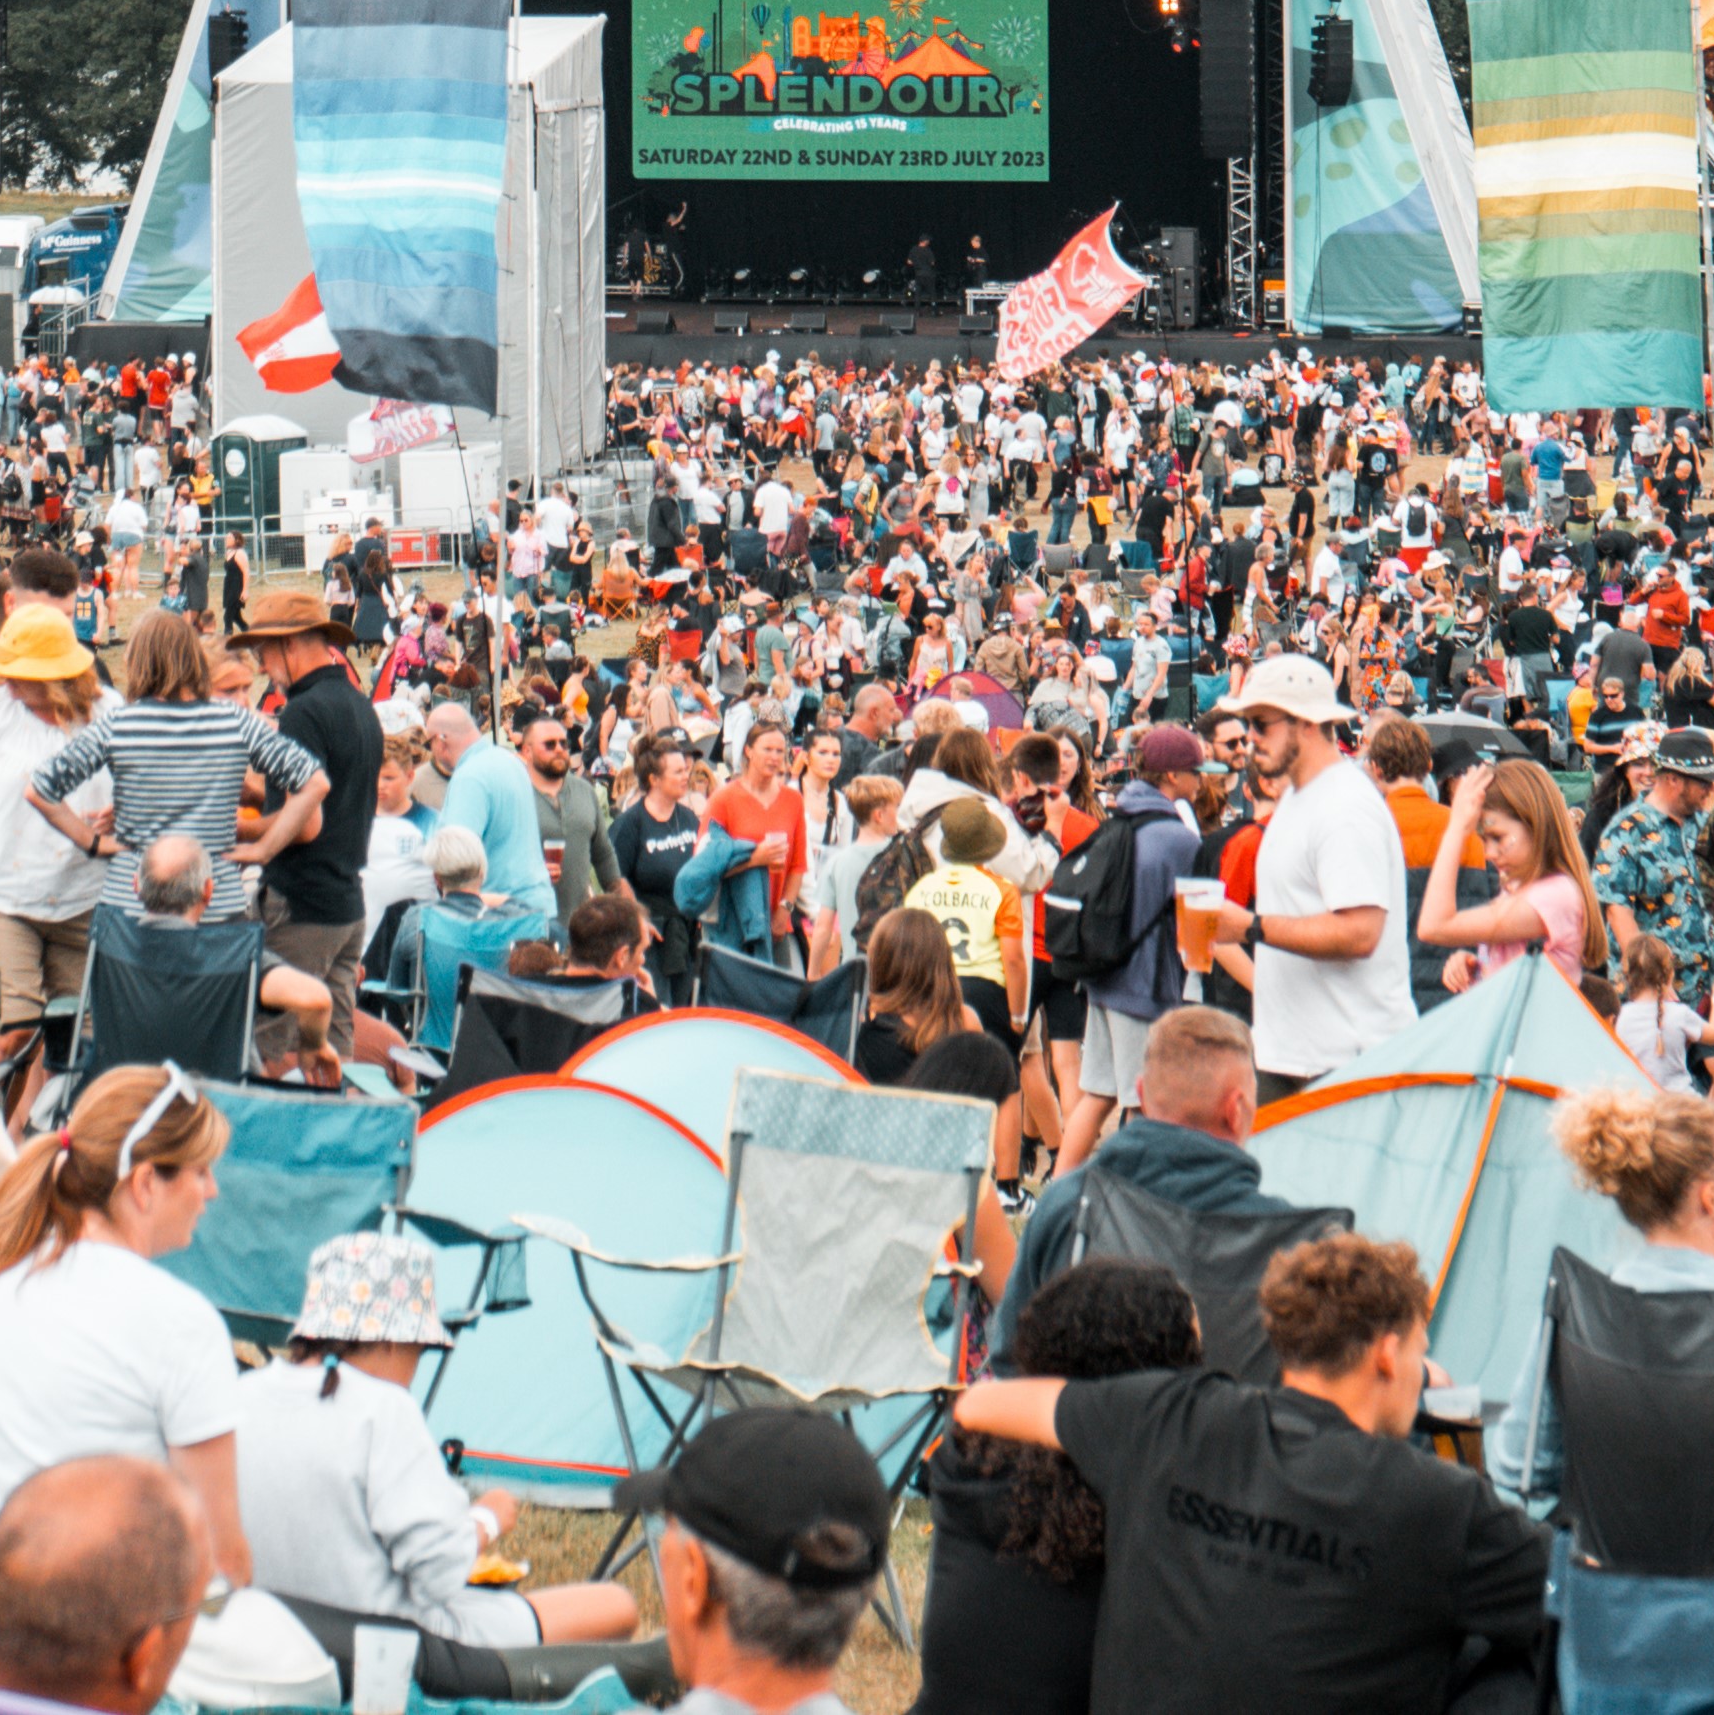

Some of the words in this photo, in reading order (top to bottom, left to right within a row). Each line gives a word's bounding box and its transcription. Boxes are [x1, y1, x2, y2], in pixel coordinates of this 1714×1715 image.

[671, 73, 1005, 115] SPLENDOUR
[773, 118, 854, 133] CELEBRATING
[855, 118, 867, 132] 15
[868, 117, 907, 132] YEARS
[638, 148, 738, 165] SATURDAY
[742, 149, 792, 166] 22ND
[798, 150, 811, 165] &
[815, 150, 895, 167] SUNDAY
[899, 151, 948, 167] 23RD
[952, 151, 997, 168] JULY
[1002, 151, 1045, 167] 2023
[921, 890, 991, 910] COLBACK
[1166, 1484, 1373, 1580] ESSENTIALS
